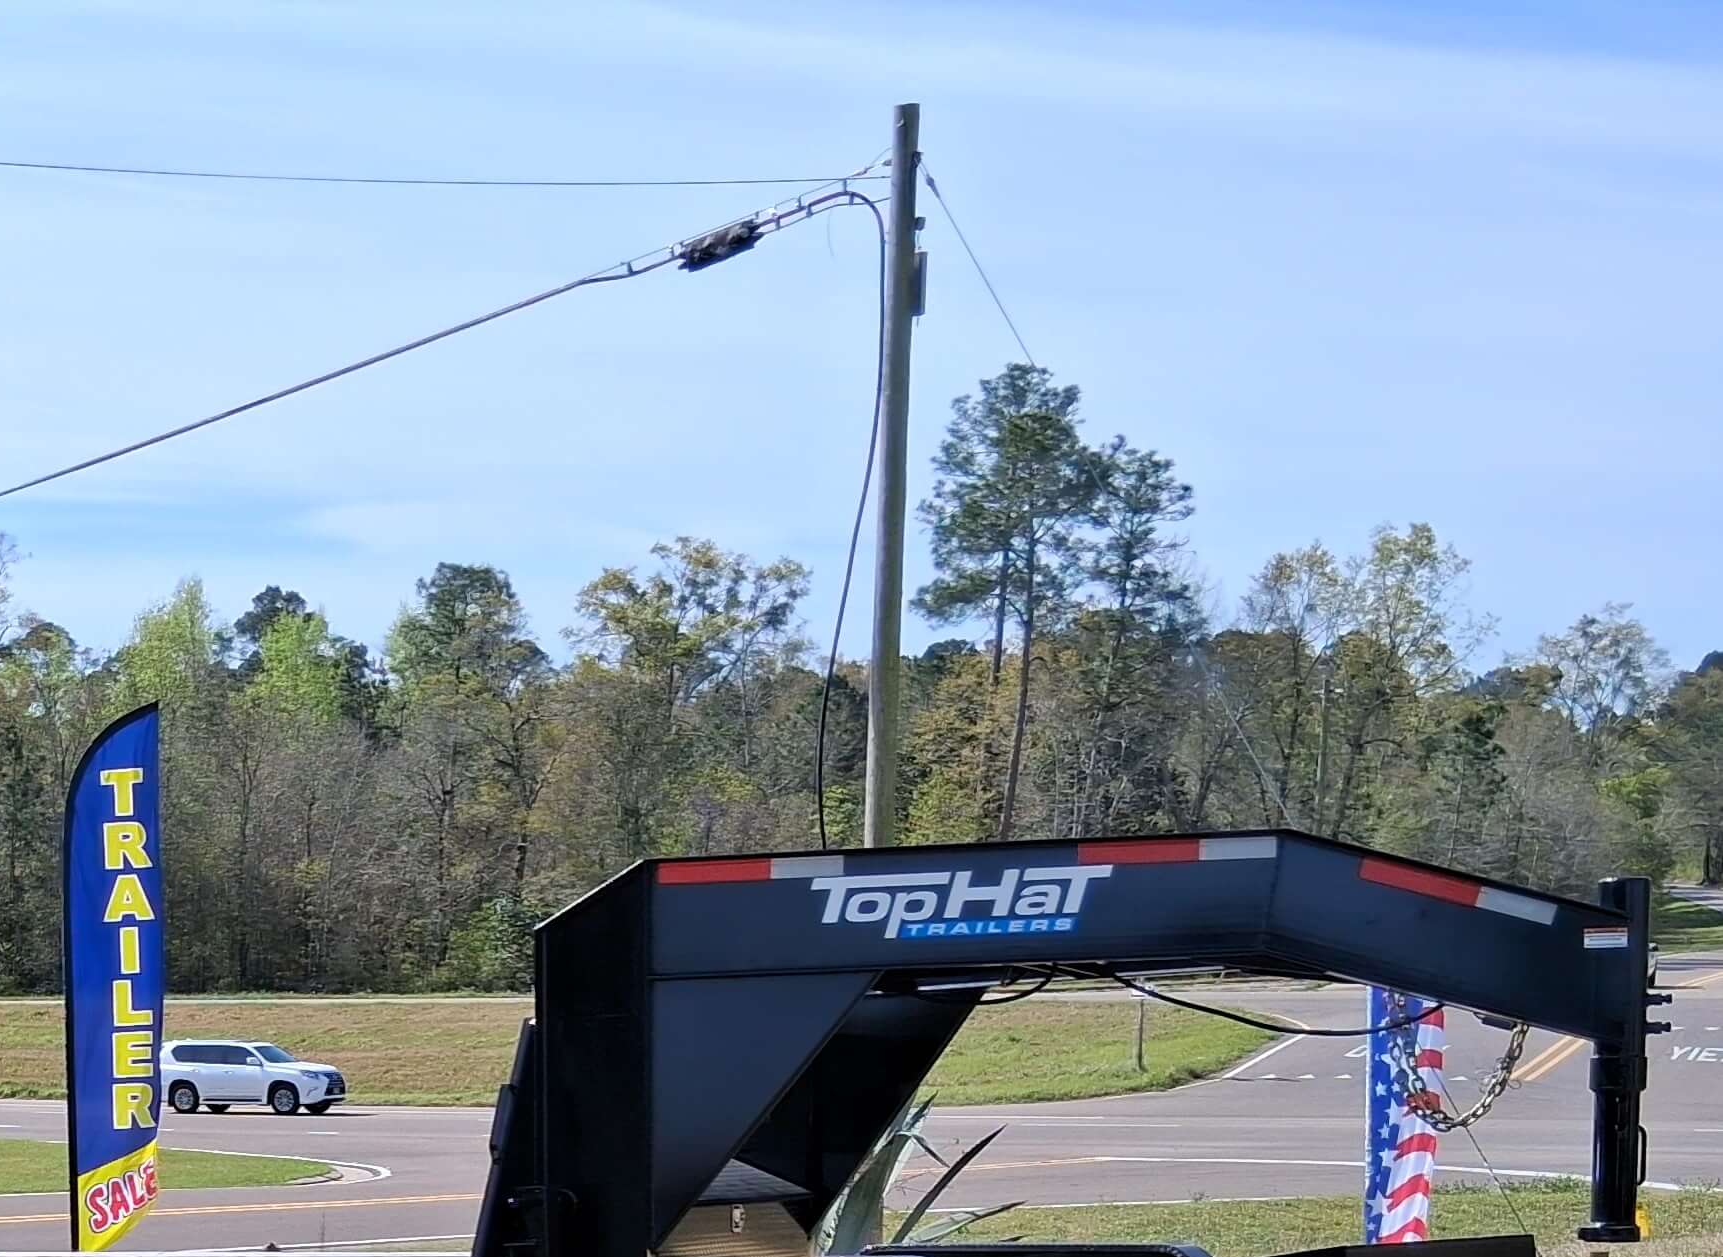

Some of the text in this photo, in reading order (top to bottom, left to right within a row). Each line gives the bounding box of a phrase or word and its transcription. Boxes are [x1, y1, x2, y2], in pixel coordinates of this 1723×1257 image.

[100, 767, 158, 1130] TRAILER
[906, 917, 1073, 937] TRAILERS
[1670, 1046, 1723, 1063] YIE
[86, 1156, 158, 1233] SALE
